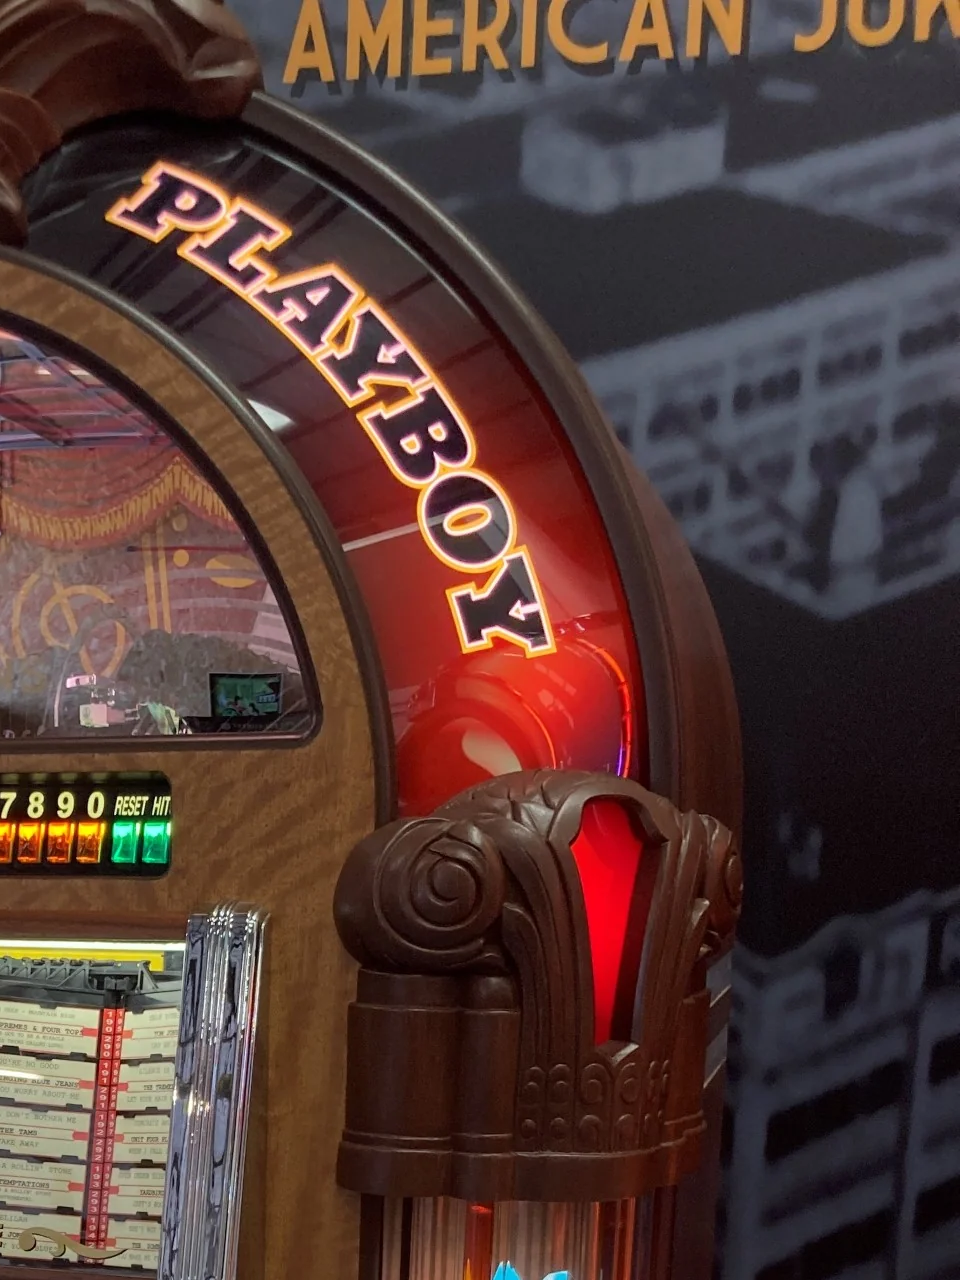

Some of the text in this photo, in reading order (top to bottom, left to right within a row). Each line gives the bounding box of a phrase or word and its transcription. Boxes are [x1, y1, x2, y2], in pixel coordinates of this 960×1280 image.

[282, 0, 743, 84] AMERICAN
[105, 160, 557, 659] PLAYBOY
[0, 791, 17, 819] 7
[27, 791, 44, 819] 8
[57, 791, 75, 819] 9
[87, 791, 105, 819] 0
[114, 796, 148, 817] RESET
[41, 1026, 61, 1034] FOUR
[26, 1060, 36, 1068] NO
[39, 1062, 60, 1070] GOOD
[31, 1078, 51, 1086] BLUE
[54, 1080, 80, 1088] JEANS
[42, 1088, 65, 1098] ABOUT
[69, 1092, 80, 1100] ME
[5, 1110, 29, 1119] DON'T
[34, 1113, 63, 1123] BOTHER
[18, 1128, 38, 1136] TAMS
[19, 1139, 40, 1148] AWAY
[49, 1166, 73, 1175] STONE
